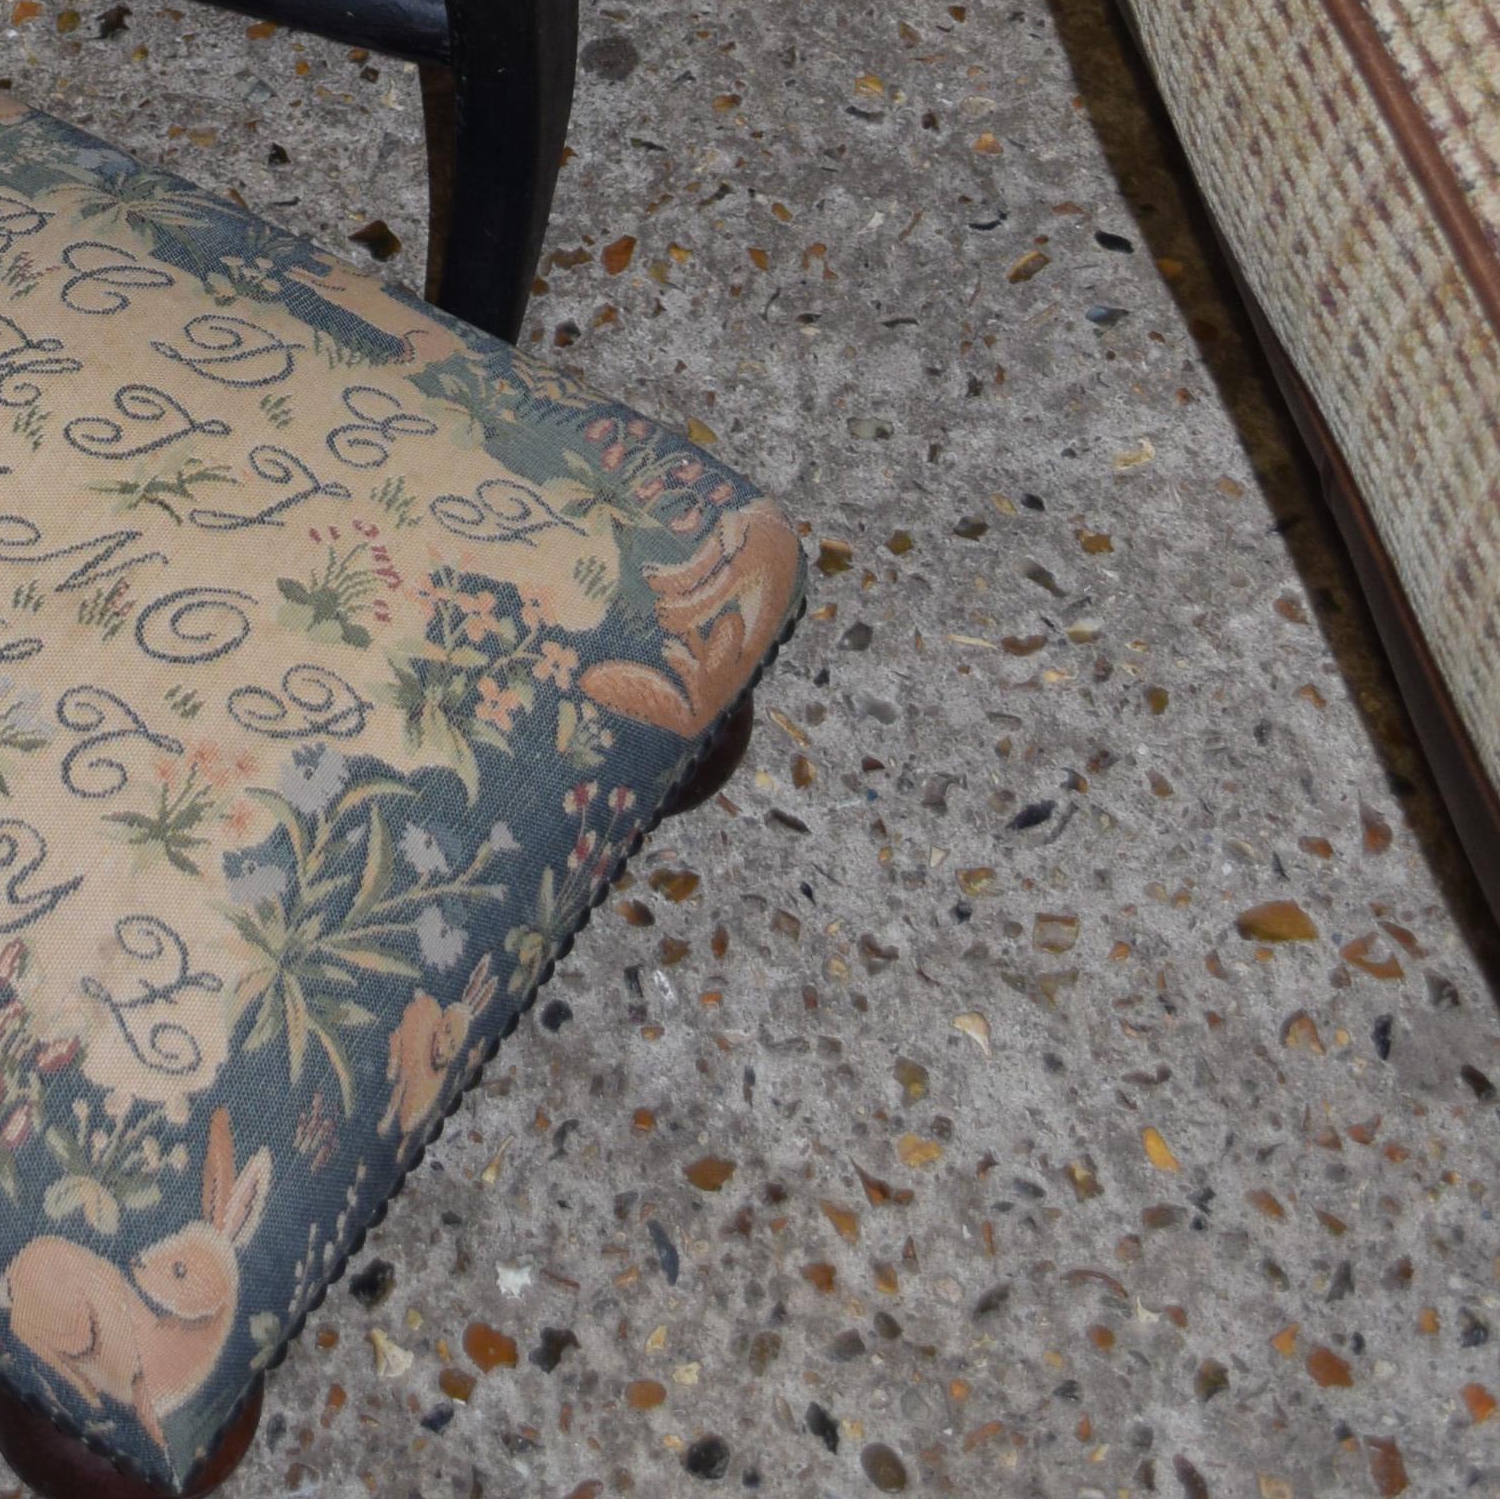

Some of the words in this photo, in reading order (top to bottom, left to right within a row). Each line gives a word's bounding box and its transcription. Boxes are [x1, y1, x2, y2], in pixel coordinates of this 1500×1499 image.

[63, 241, 174, 315] C
[151, 314, 304, 387] D
[326, 385, 437, 468] E
[135, 587, 259, 664] O
[227, 663, 373, 740] P
[81, 916, 224, 1074] Z
